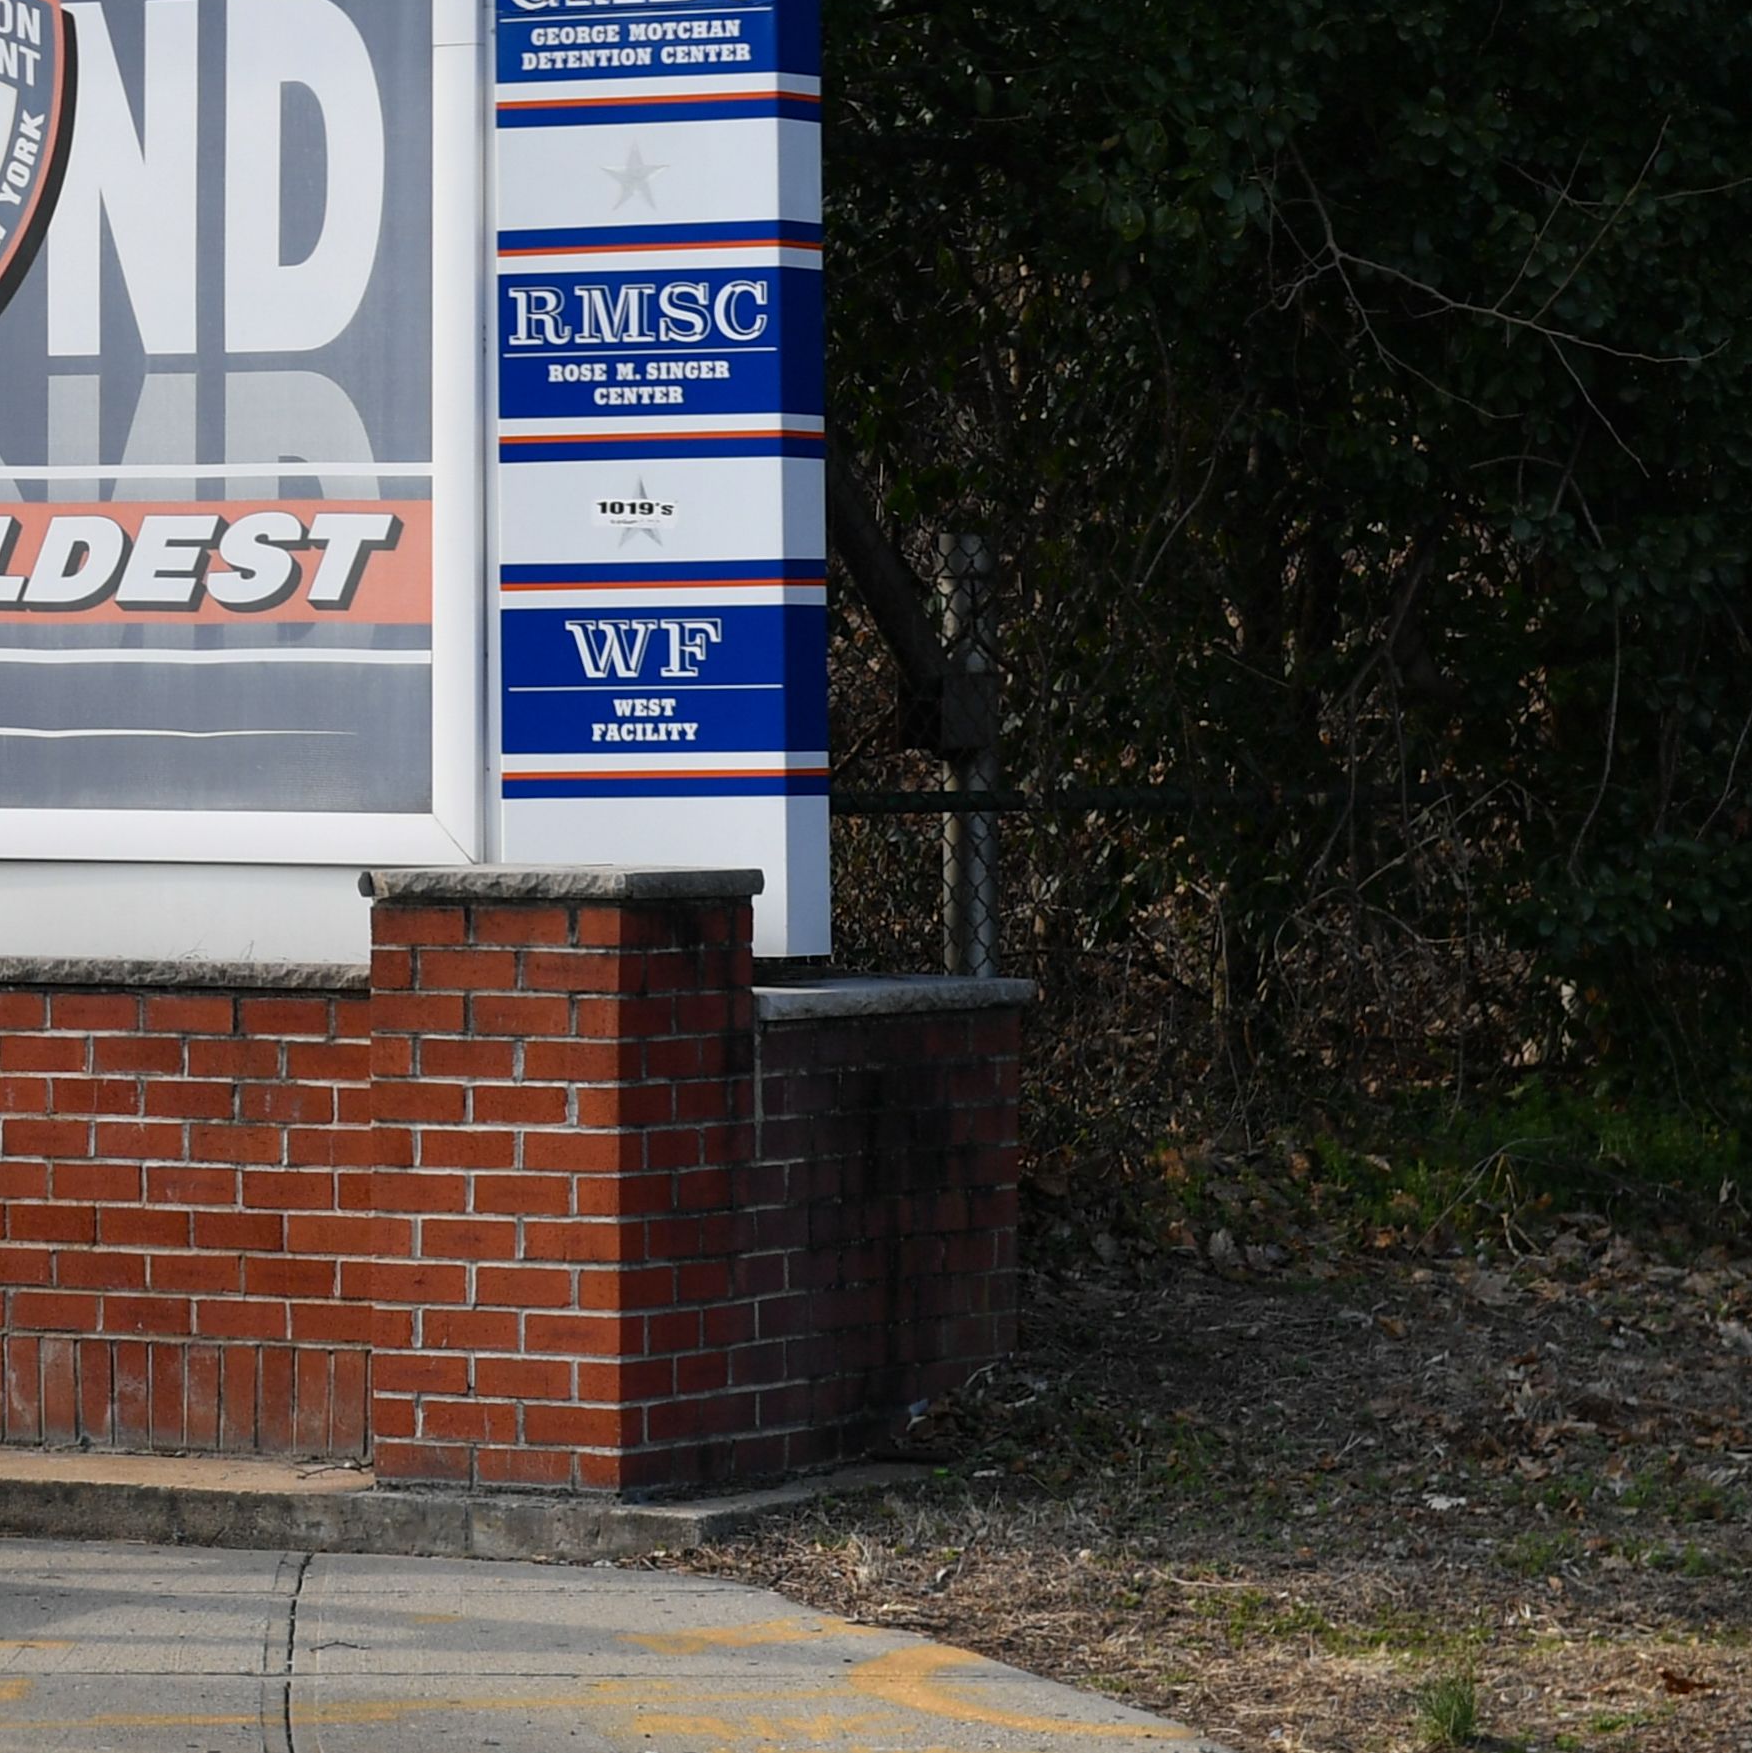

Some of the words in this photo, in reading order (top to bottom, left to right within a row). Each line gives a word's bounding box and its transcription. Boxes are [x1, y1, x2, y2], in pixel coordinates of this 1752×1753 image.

[530, 24, 620, 47] GEORGE
[627, 19, 741, 43] MOTCHAN
[521, 47, 653, 71] DETENTION
[661, 43, 752, 65] CENTER
[507, 279, 768, 346] RMSC
[548, 363, 608, 383] ROSE
[615, 362, 642, 381] M.
[645, 360, 730, 380] SINGER
[593, 386, 685, 406] CENTER
[596, 500, 675, 516] 1019's
[564, 618, 722, 679] WF
[613, 698, 677, 717] WEST
[591, 723, 699, 742] FACILITY
